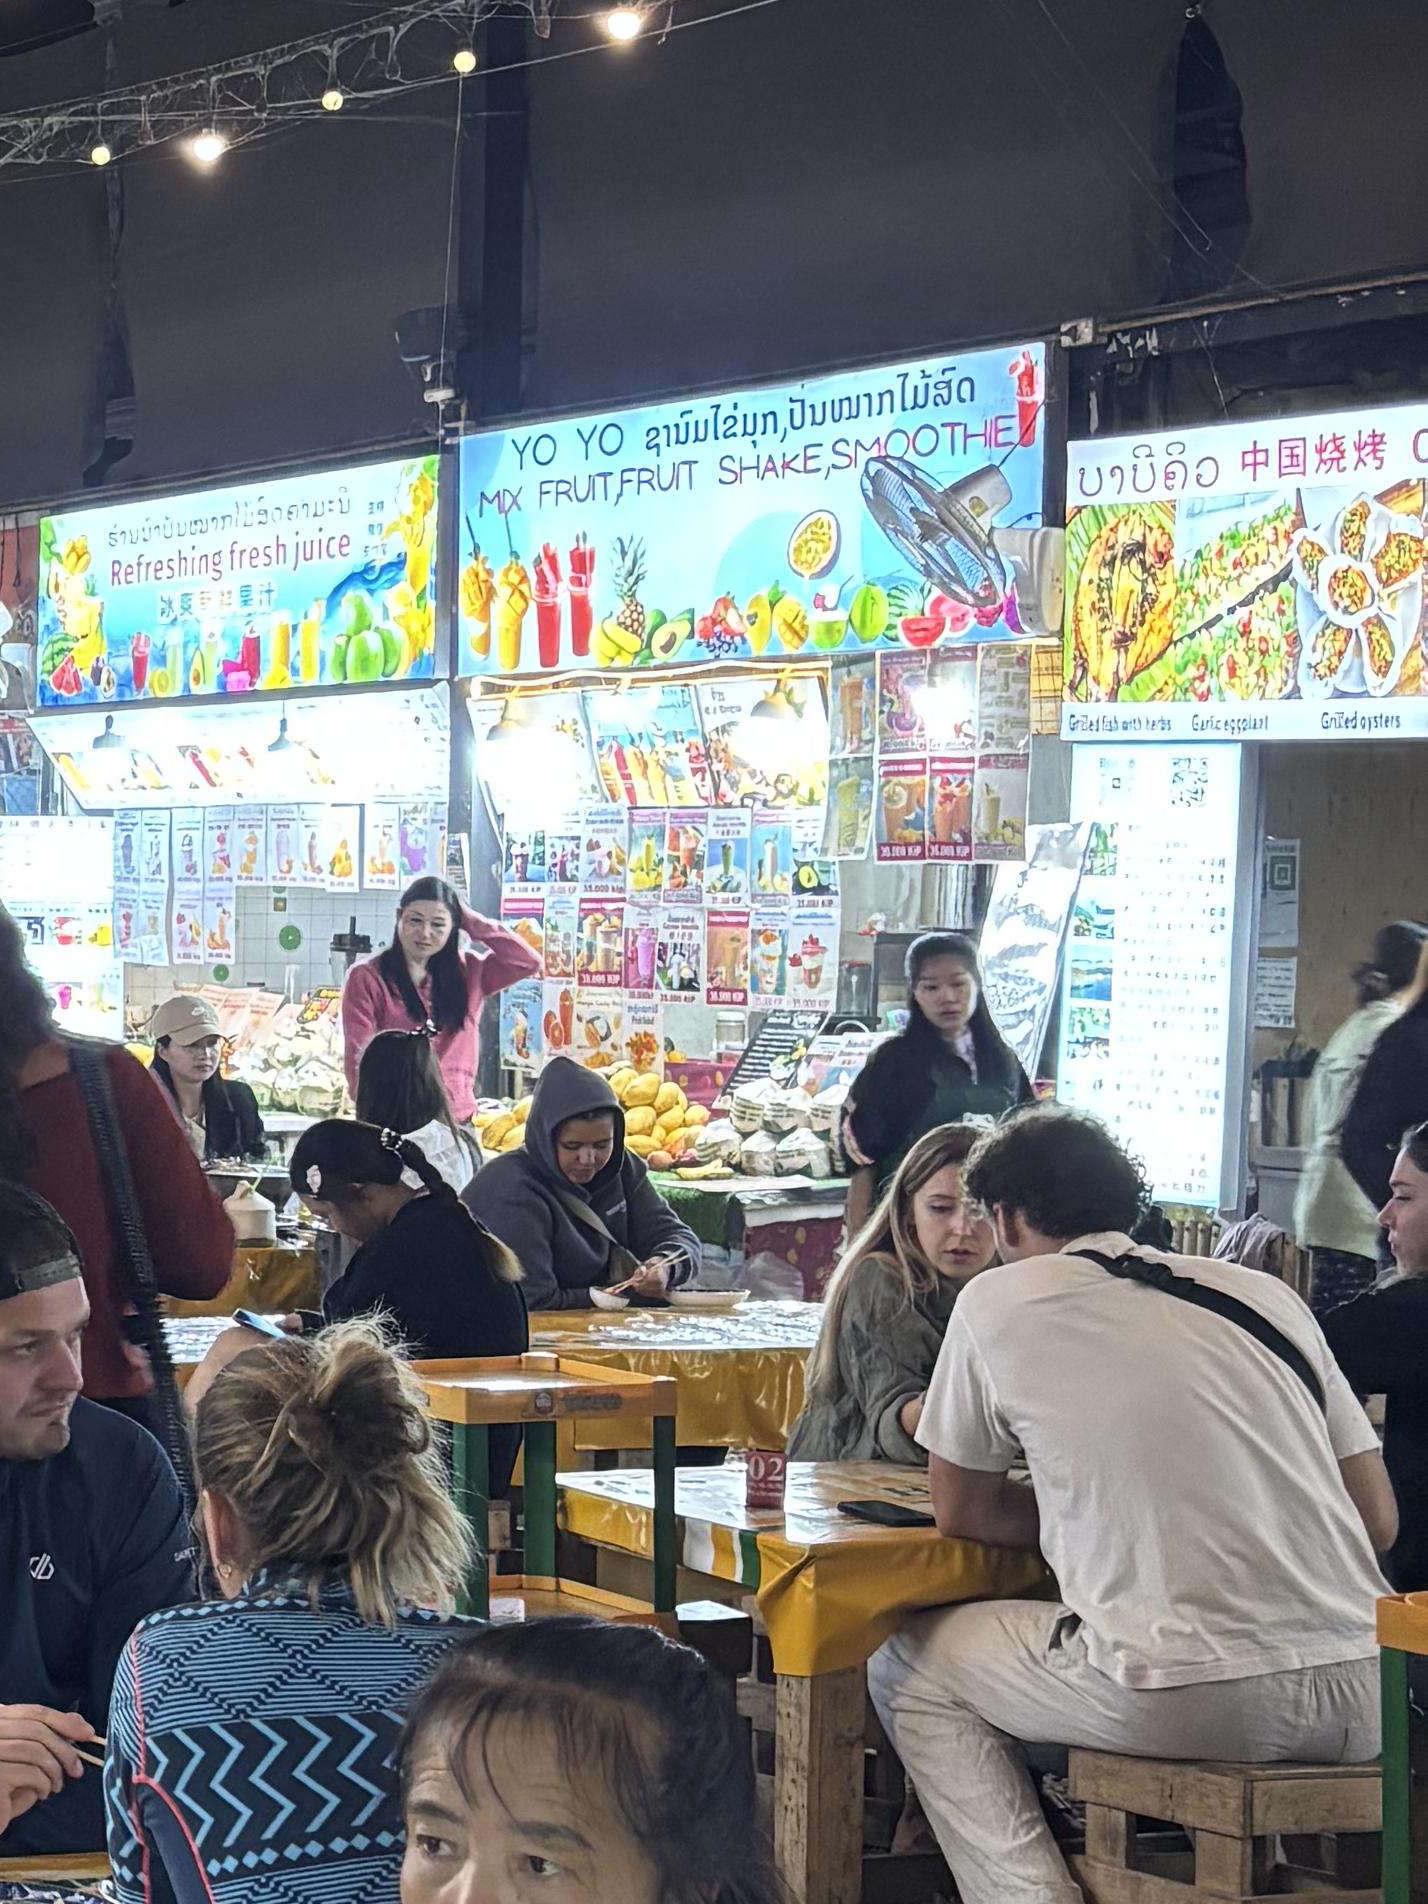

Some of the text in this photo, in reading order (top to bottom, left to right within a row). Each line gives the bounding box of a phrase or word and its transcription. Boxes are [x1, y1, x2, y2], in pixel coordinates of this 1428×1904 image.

[511, 433, 557, 470] YO
[577, 422, 624, 461] YO
[1241, 428, 1388, 482] 中国烧烤
[478, 486, 522, 518] MIX
[111, 546, 223, 586] Refreshing
[230, 534, 287, 571] fresh
[293, 527, 351, 571] juice
[1360, 709, 1401, 733] oysters
[748, 1457, 783, 1481] 02
